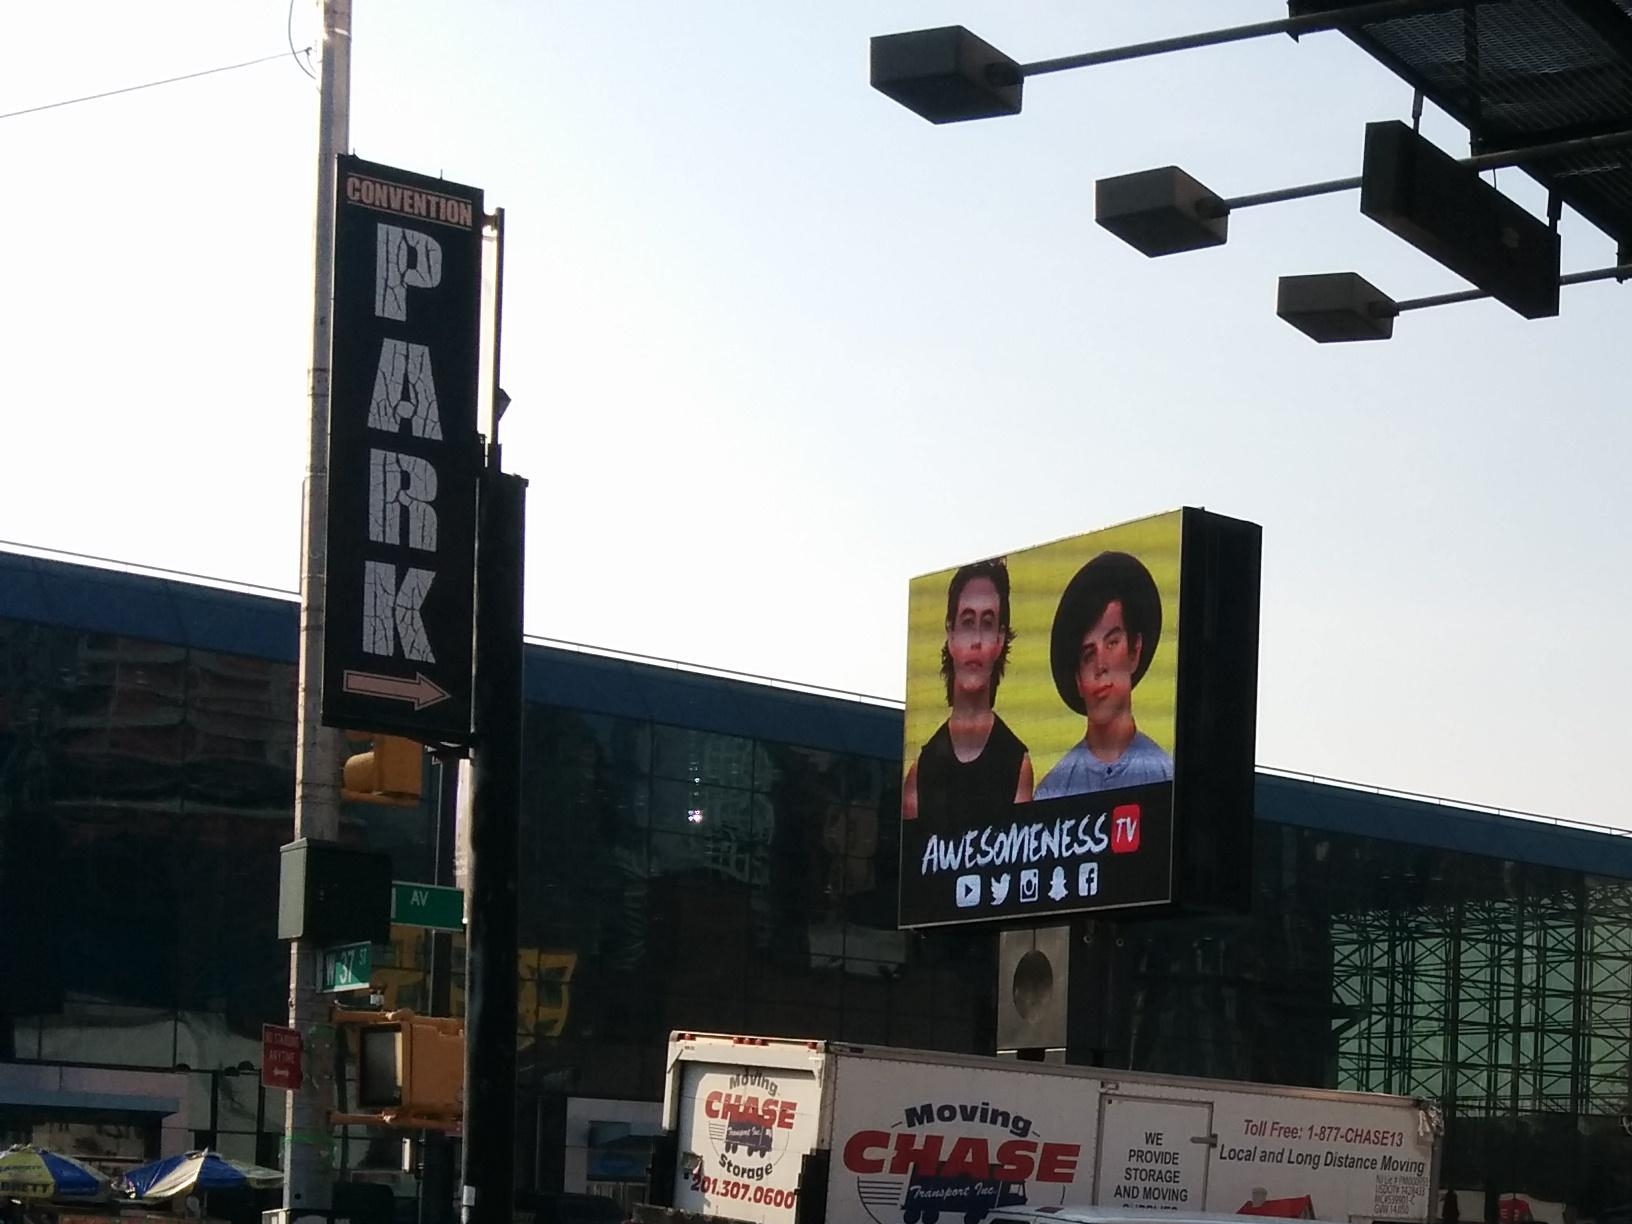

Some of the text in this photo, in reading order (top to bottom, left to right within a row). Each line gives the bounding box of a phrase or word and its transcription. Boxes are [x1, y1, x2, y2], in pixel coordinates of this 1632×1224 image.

[346, 176, 472, 226] CONVENTION
[362, 223, 442, 664] PARK
[922, 812, 1137, 876] AWESOMENESS TV
[411, 889, 429, 907] AV
[327, 953, 336, 986] W
[340, 949, 355, 985] 37
[729, 1071, 778, 1097] Moving
[705, 1091, 797, 1129] CHASE
[905, 1102, 1032, 1138] Moving
[1145, 1131, 1163, 1146] WE
[1244, 1119, 1404, 1148] Toll Free: 1-877-CHASE13
[719, 1154, 773, 1181] Storage
[843, 1130, 1081, 1183] CHASE
[1128, 1149, 1179, 1165] PROVIDE
[1219, 1144, 1425, 1177] Local and Long Distance Moving
[1124, 1167, 1181, 1184] STORAGE
[690, 1174, 796, 1209] 201.307.0600
[910, 1184, 970, 1201] Transport
[1114, 1185, 1188, 1202] AND MOVING
